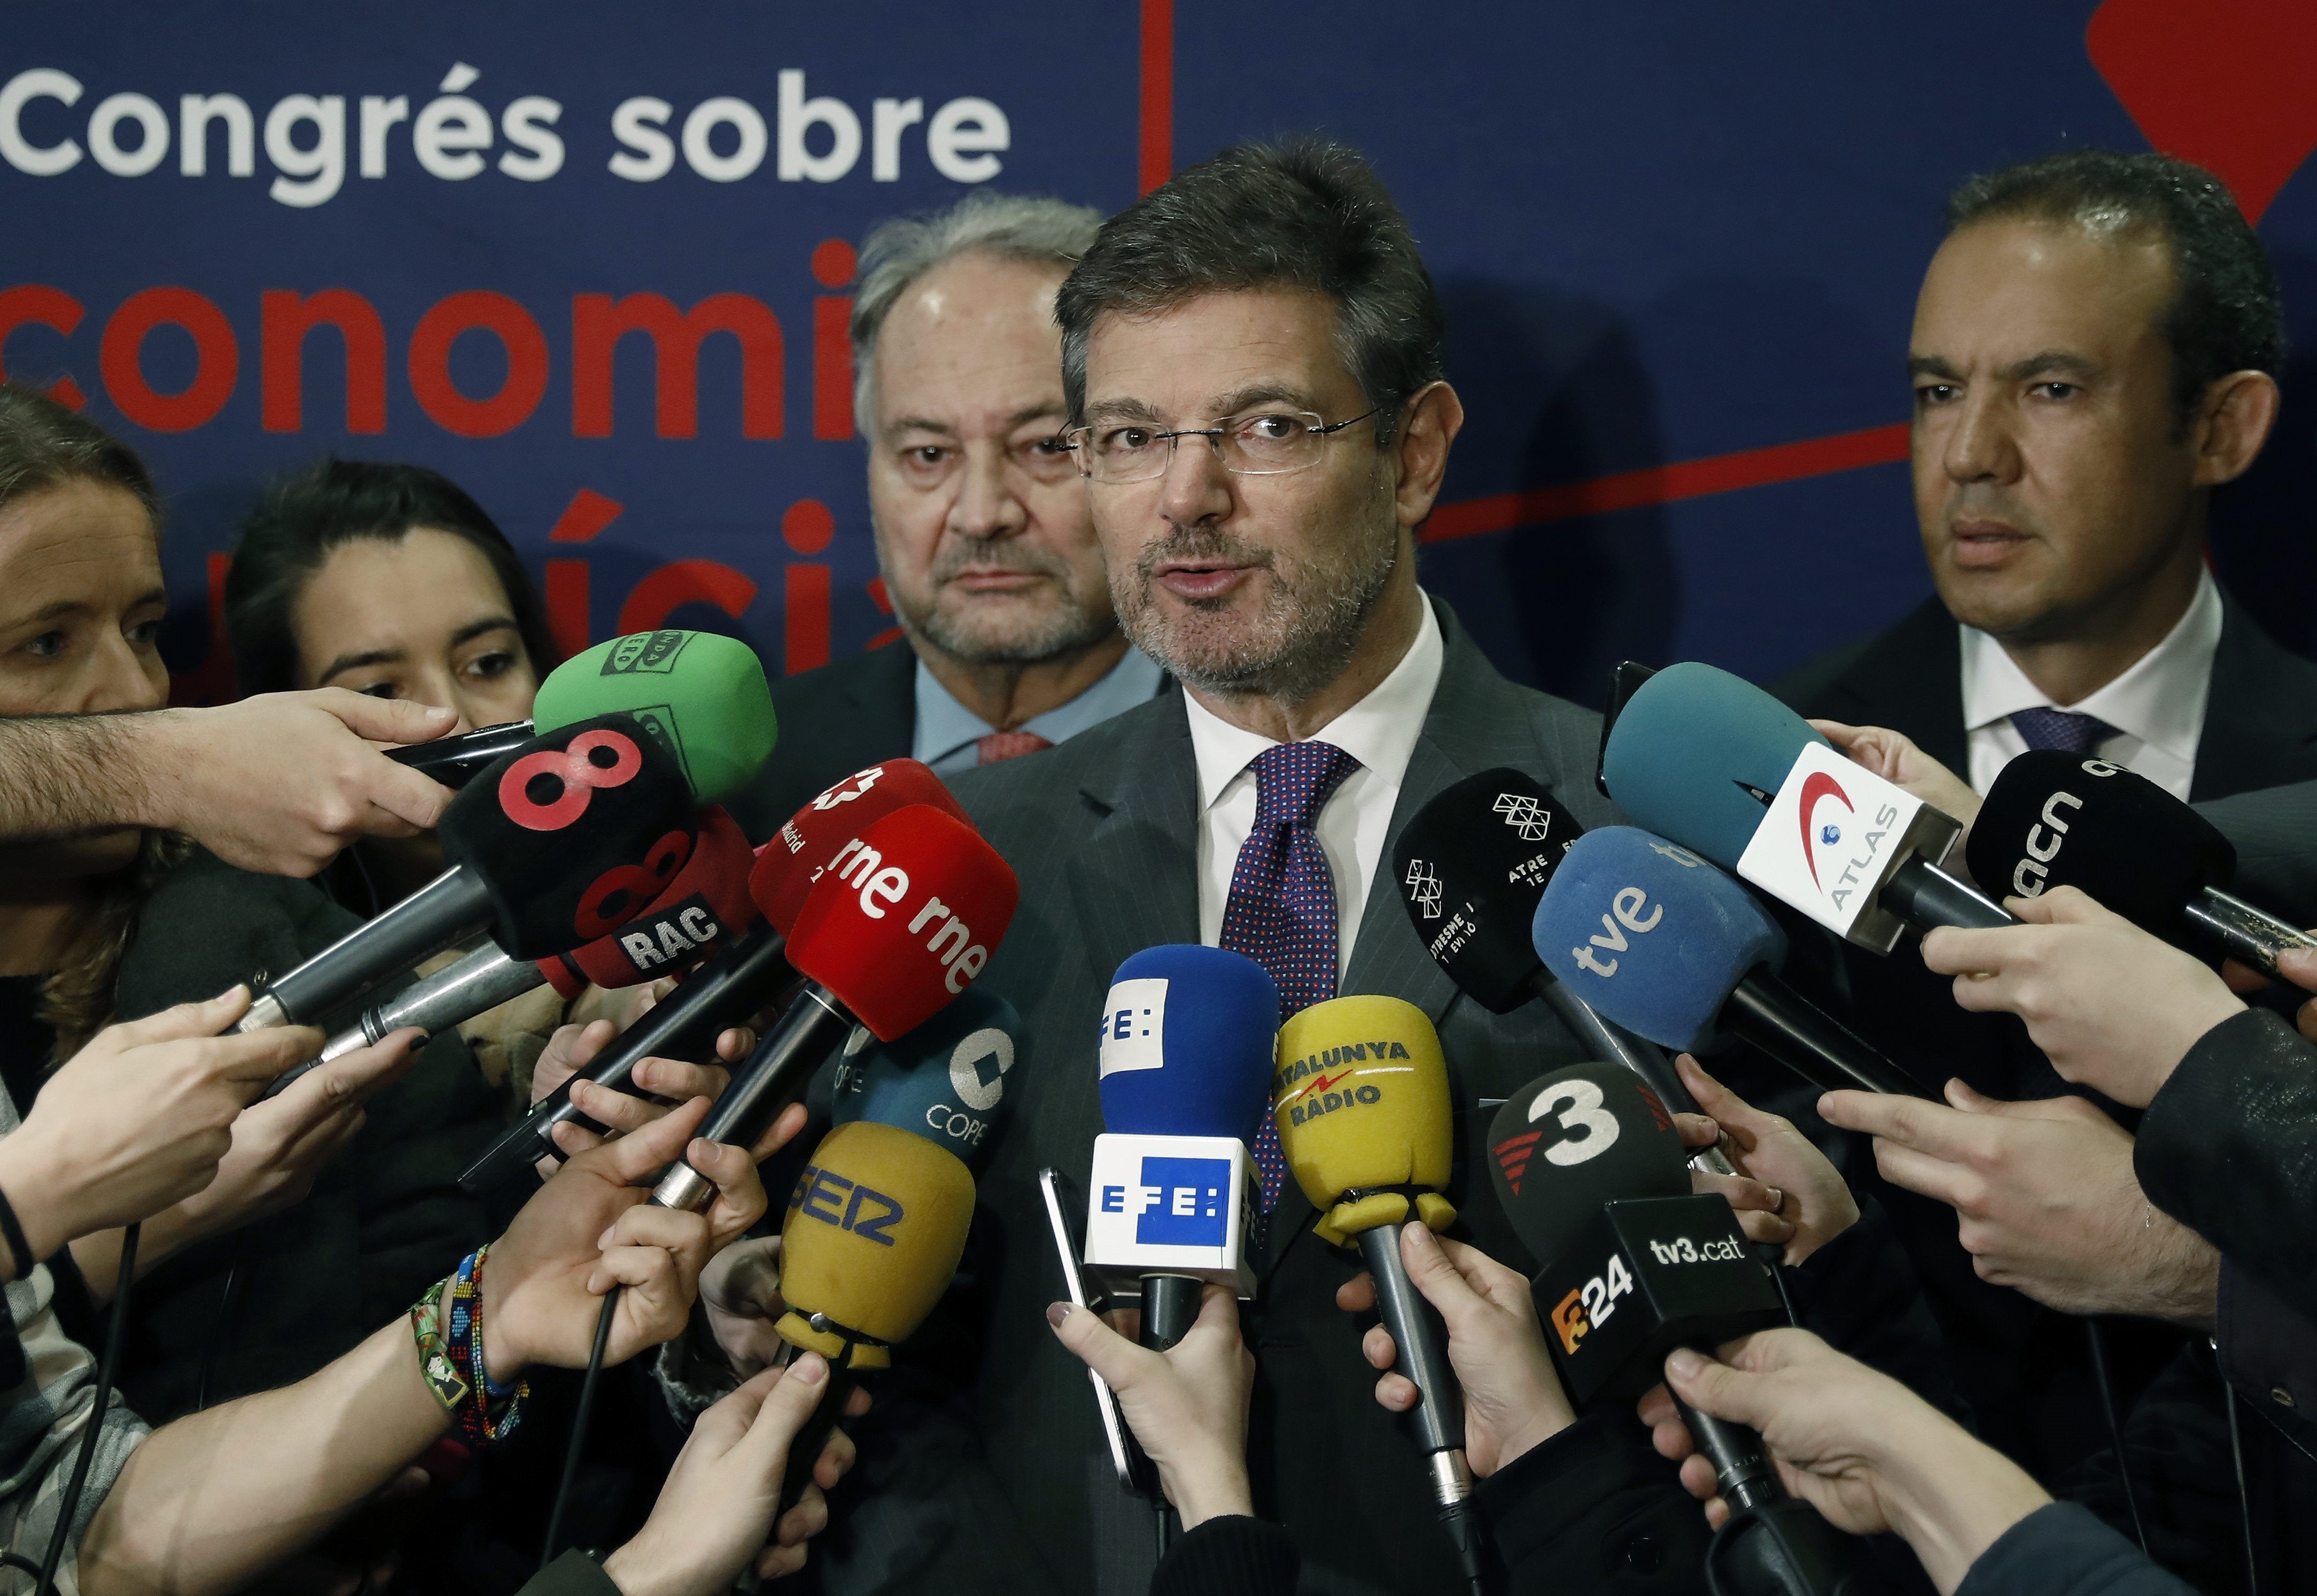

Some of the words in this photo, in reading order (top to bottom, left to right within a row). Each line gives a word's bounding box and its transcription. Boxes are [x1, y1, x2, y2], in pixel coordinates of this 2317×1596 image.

[0, 61, 565, 208] Congrés
[608, 68, 1010, 183] sobre
[827, 837, 909, 919] rne
[1831, 804, 1898, 912] ATLAS
[2013, 791, 2083, 899] acn
[620, 906, 718, 970] RAC
[908, 896, 988, 994] rne
[1572, 886, 1663, 978] tve
[926, 1104, 988, 1146] COPE
[1290, 1085, 1381, 1127] RÀDIO
[1528, 1079, 1620, 1166] 3
[1649, 1235, 1745, 1265] tv3.cat
